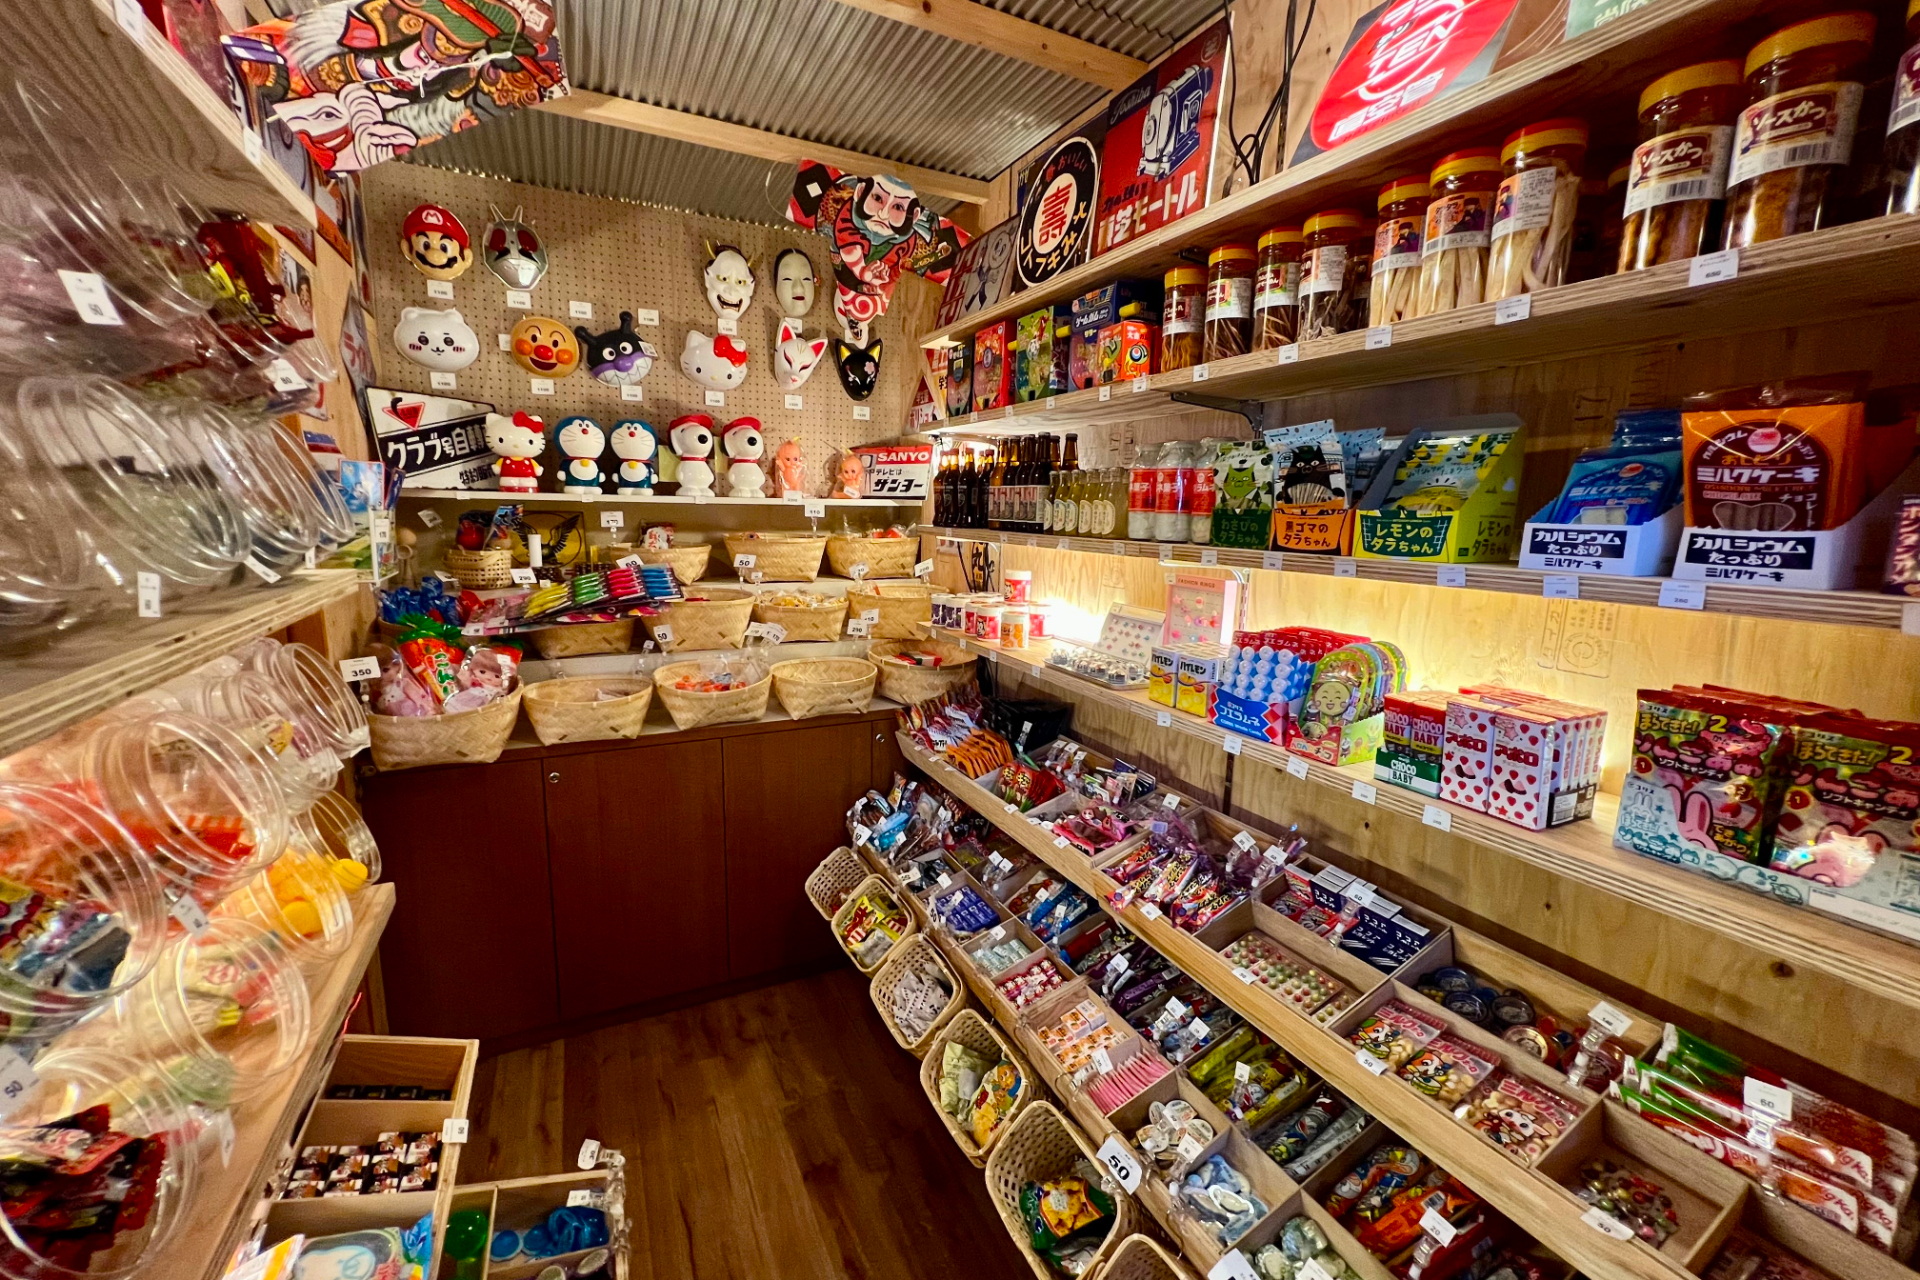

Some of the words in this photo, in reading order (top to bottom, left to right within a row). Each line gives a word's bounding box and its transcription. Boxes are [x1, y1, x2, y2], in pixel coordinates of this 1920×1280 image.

[877, 452, 929, 461] SANYO
[1697, 466, 1819, 483] ミルクケーキ
[872, 478, 923, 492] サンヨー
[1568, 481, 1663, 497] ミルクケーキ
[1221, 519, 1258, 531] わさびの
[1286, 521, 1329, 534] 黒ゴマの
[1376, 524, 1433, 538] レモンの
[1220, 531, 1259, 544] タラちゃん
[1283, 534, 1331, 547] タラちゃん
[1534, 530, 1621, 545] カルシウム
[1370, 538, 1434, 554] タラちゃん
[1547, 543, 1602, 555] たっぷり
[1692, 537, 1806, 554] カルシウム
[1544, 557, 1603, 569] ミルクケーキ
[1708, 553, 1782, 567] たっぷり
[1705, 567, 1784, 582] ミルクケーキ
[657, 631, 668, 641] 50
[1152, 653, 1173, 666] ハイレモン
[352, 667, 372, 677] 350
[1180, 661, 1206, 675] ハイレモン
[1220, 705, 1260, 727] フエラムネ
[1412, 717, 1442, 734] CHOCO
[1709, 715, 1728, 733] 2
[1414, 731, 1440, 746] BABY
[1446, 731, 1488, 753] アポロ
[1494, 743, 1540, 767] アポロ
[1890, 746, 1913, 765] 2
[1391, 759, 1416, 775] CHOCO
[1659, 757, 1725, 779] ソフトキャンディ
[1392, 771, 1414, 785] BABY
[1823, 791, 1908, 816] ソフトキャンディ
[5, 1081, 23, 1099] 50
[1760, 1099, 1775, 1109] 60
[1107, 1154, 1130, 1182] 50
